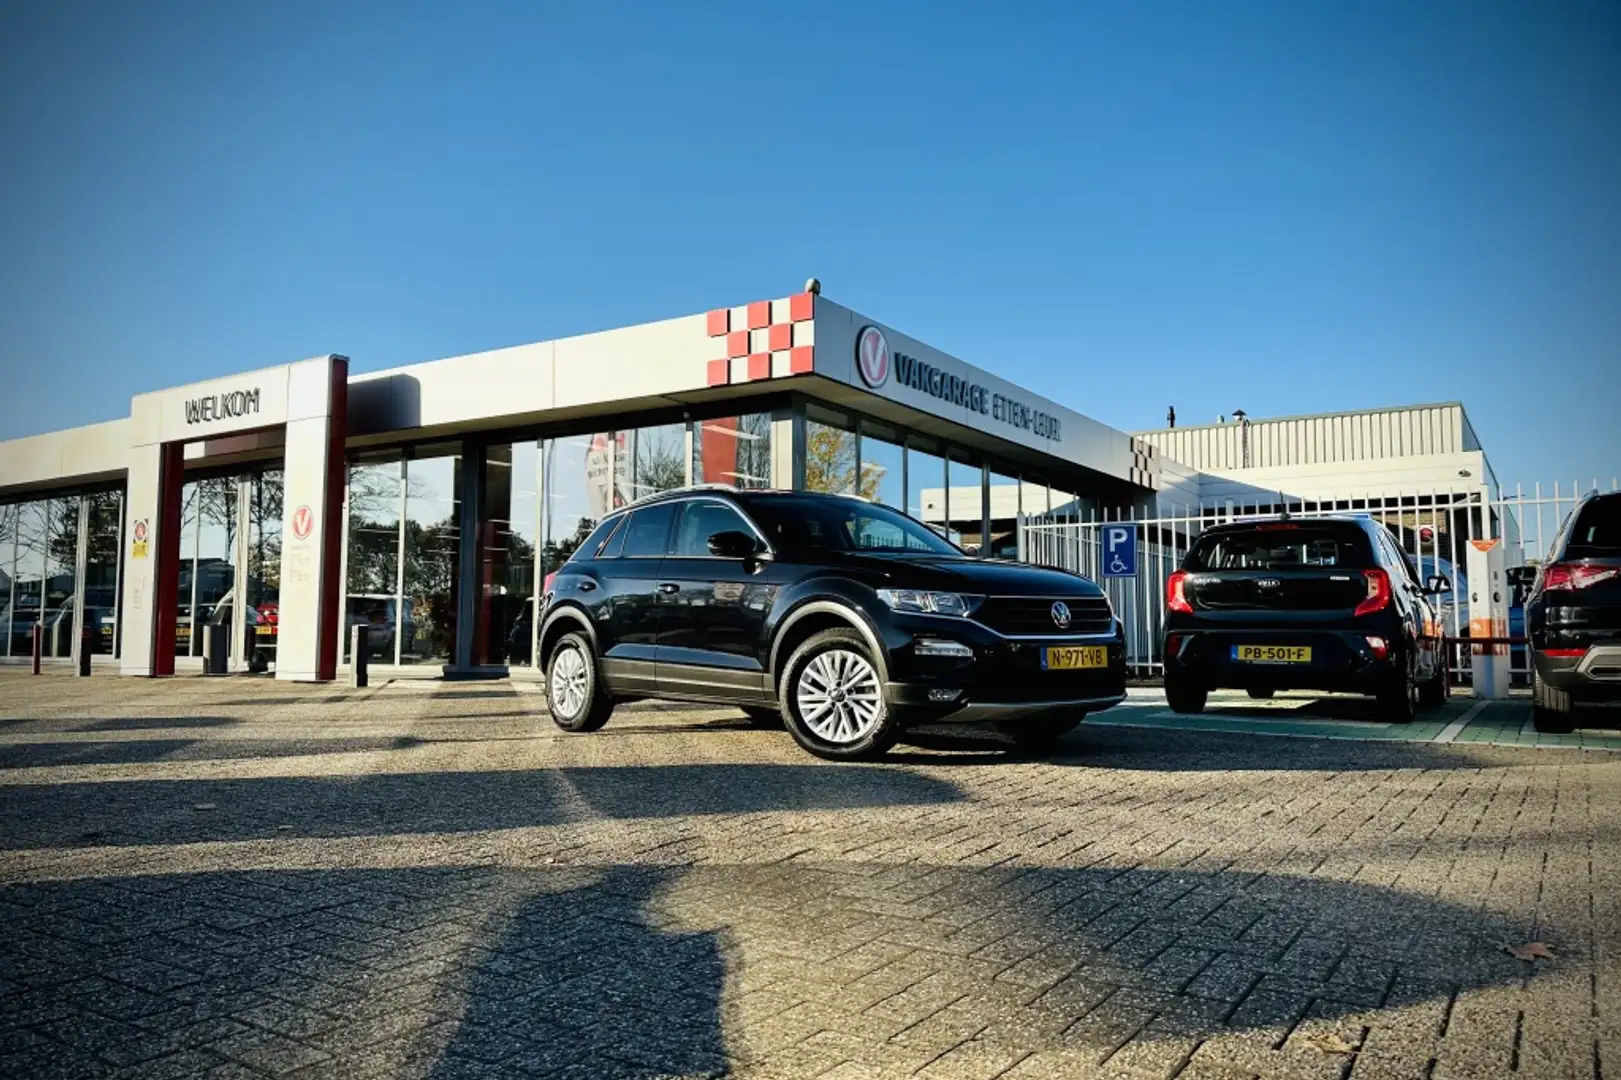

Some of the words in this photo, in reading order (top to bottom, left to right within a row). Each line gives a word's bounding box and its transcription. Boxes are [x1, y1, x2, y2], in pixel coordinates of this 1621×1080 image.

[894, 352, 989, 416] VAKGARAGE
[185, 386, 260, 425] WELKOM
[1109, 528, 1128, 552] P
[1052, 650, 1103, 666] N-971-VB
[1244, 647, 1305, 660] PB-501-F
